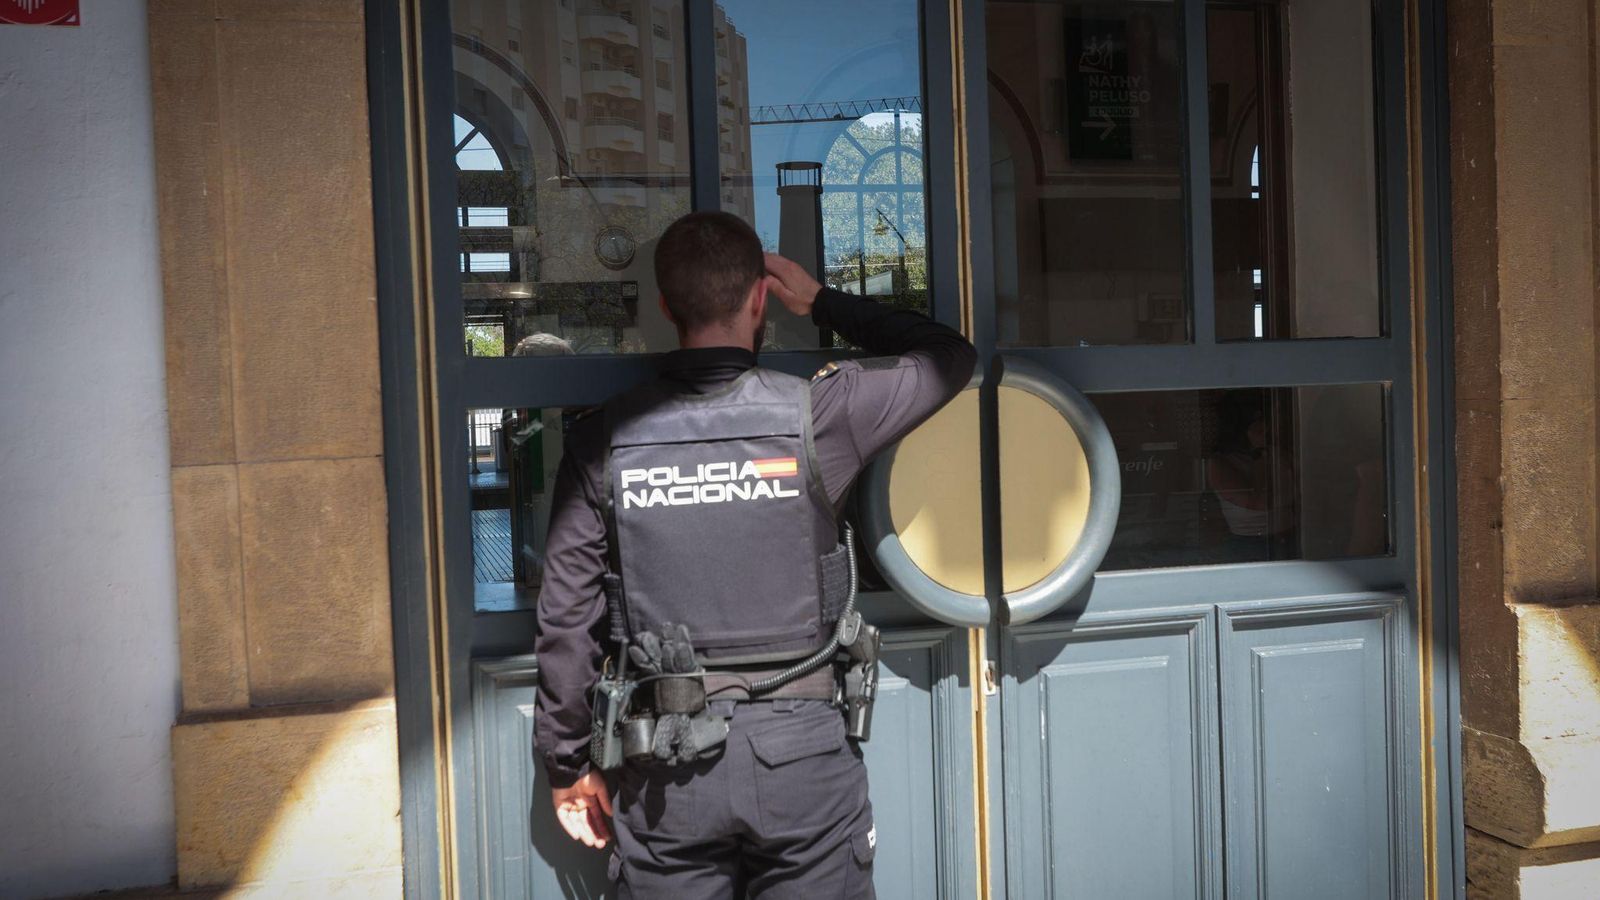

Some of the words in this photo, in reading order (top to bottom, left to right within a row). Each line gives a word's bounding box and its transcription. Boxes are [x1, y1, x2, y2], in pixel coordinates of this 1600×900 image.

[1088, 75, 1142, 88] NATHY
[1088, 90, 1151, 103] PELUSO
[620, 460, 762, 489] POLICIA
[622, 479, 801, 510] NACIONAL
